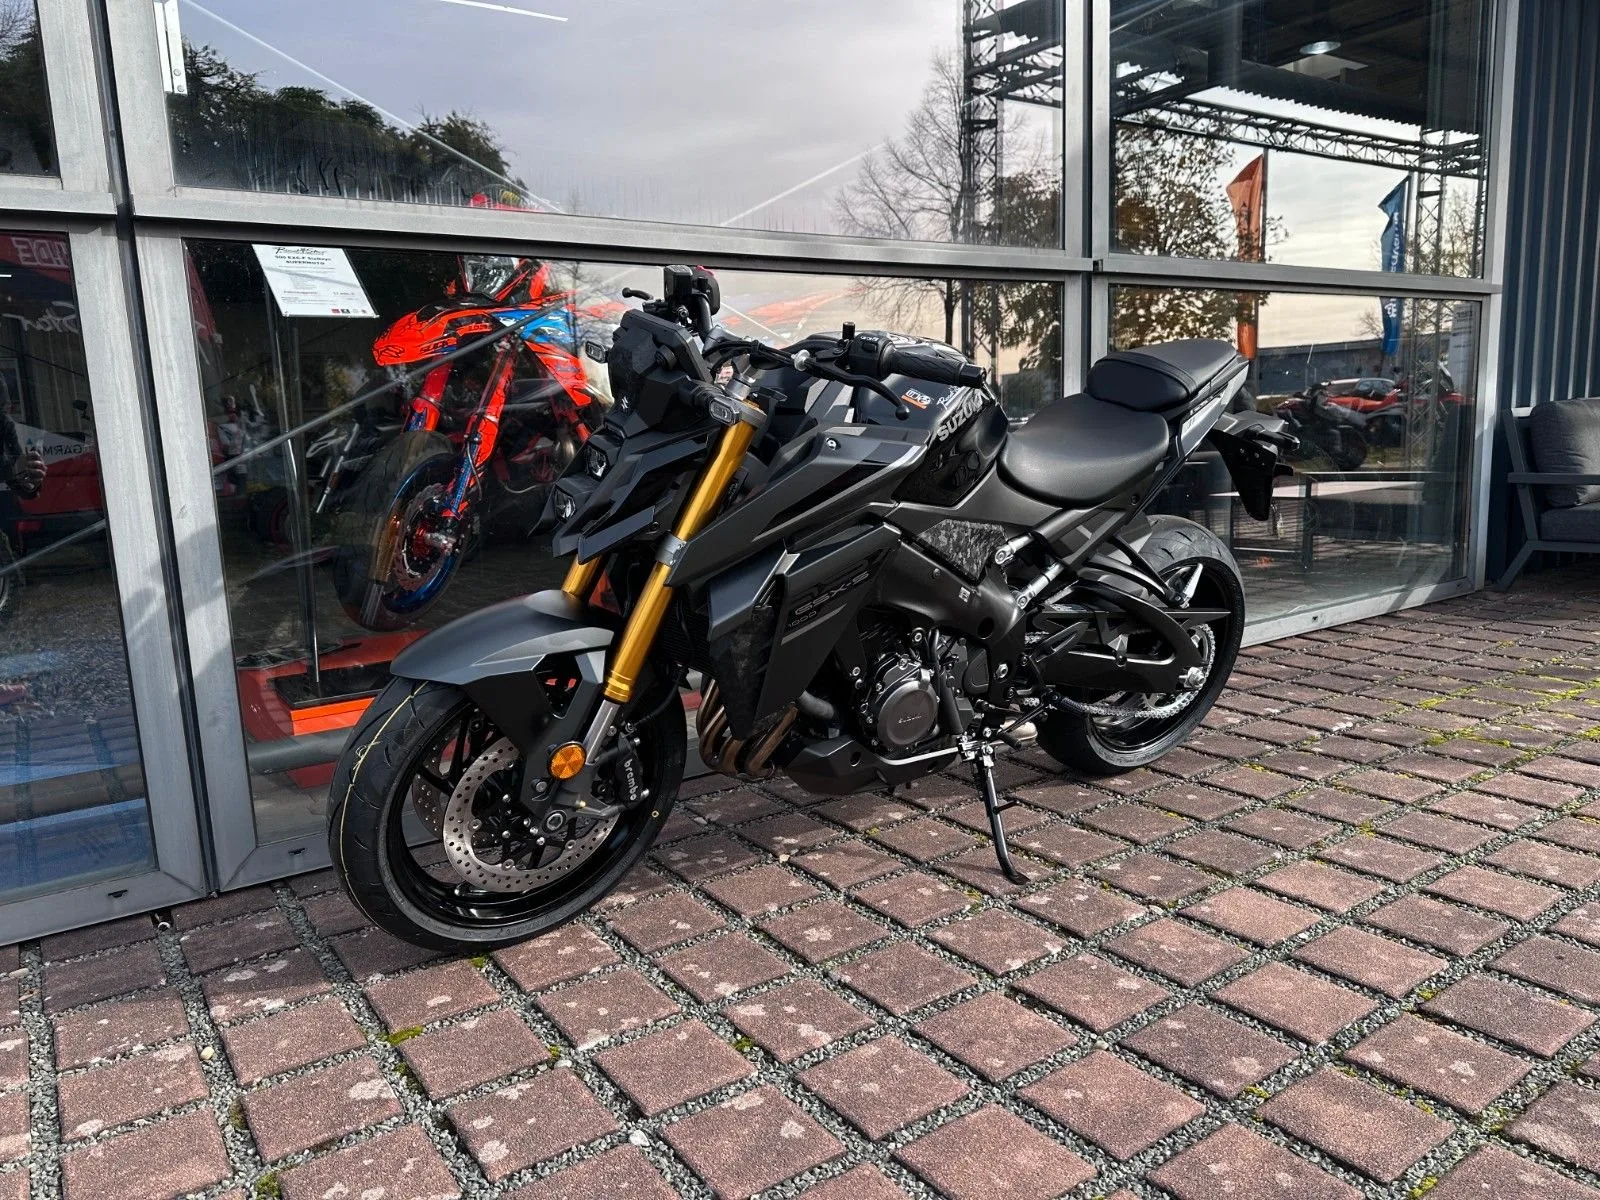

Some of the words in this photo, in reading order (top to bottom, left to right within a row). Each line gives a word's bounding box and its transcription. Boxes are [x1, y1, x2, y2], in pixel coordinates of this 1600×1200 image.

[794, 571, 870, 615] GSX-S
[788, 610, 817, 628] 1000
[624, 758, 639, 801] brembo
